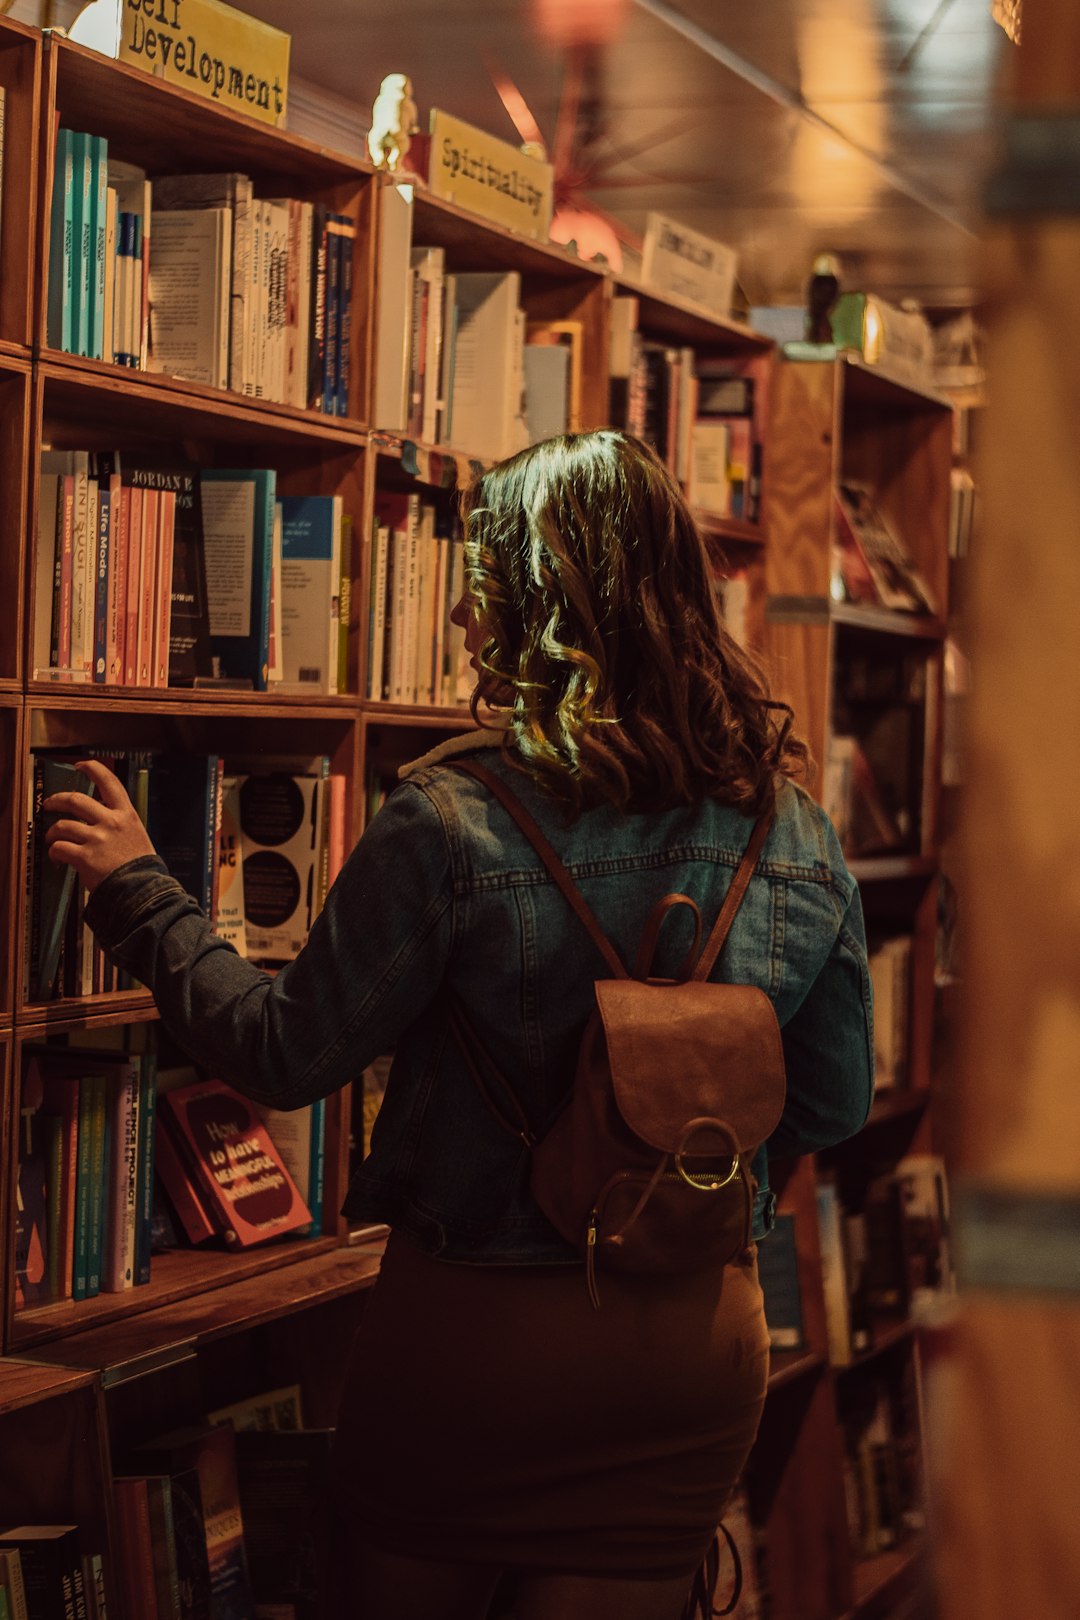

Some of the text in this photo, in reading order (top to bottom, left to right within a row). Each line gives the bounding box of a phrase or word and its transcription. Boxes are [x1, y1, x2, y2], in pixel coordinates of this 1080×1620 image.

[128, 13, 283, 114] Development
[442, 137, 543, 216] Spirituality
[316, 248, 327, 271] ANT
[132, 469, 181, 490] JORDAN
[65, 495, 74, 554] Burnout
[78, 472, 88, 570] KINTSUGI
[101, 504, 109, 533] Life
[99, 536, 108, 578] Mode
[215, 769, 223, 833] TRAUMA
[124, 1111, 132, 1164] TURNER
[128, 1071, 139, 1206] RESILIENCE PROJECT
[206, 1121, 240, 1142] How
[209, 1137, 260, 1166] to have
[62, 1575, 73, 1600] JIM
[73, 1568, 87, 1620] JIM KW
